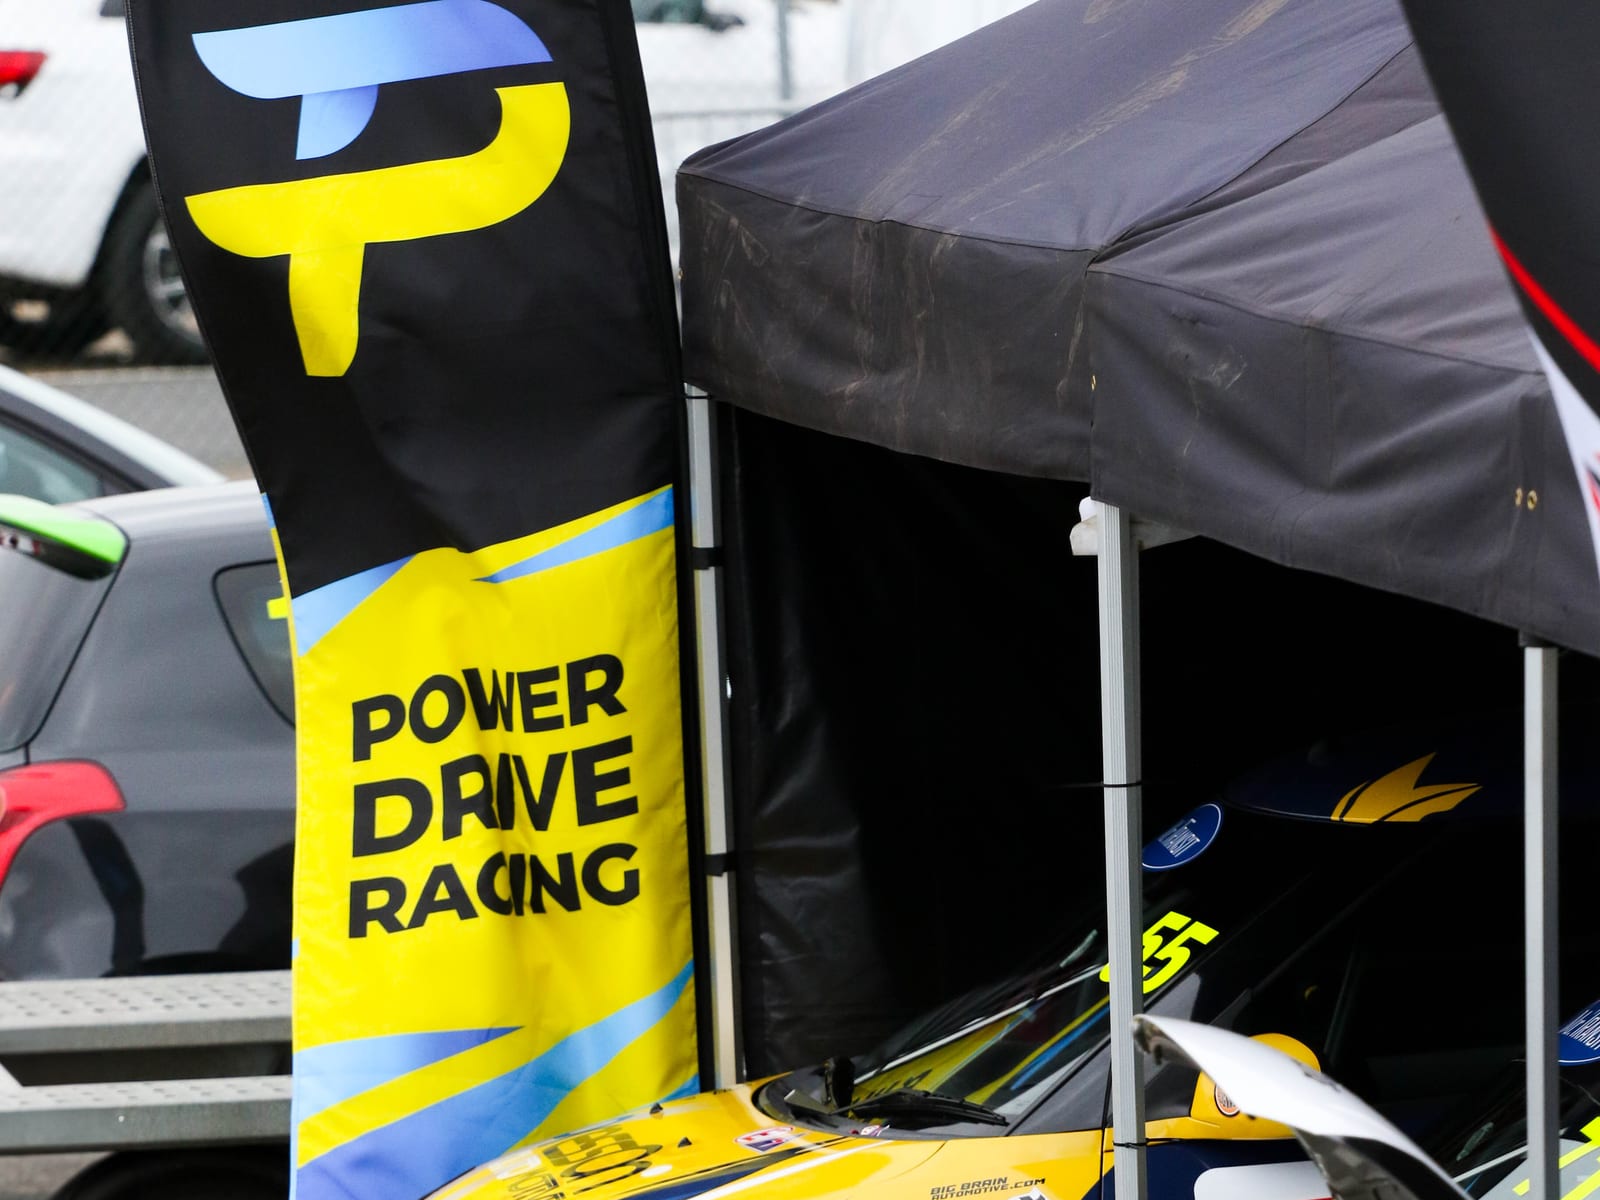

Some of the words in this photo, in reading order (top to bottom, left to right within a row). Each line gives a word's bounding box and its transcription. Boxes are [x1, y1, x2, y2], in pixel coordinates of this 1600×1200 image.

[352, 653, 628, 762] POWER
[352, 735, 640, 858] DRIVE
[348, 842, 641, 939] RACING
[930, 1184, 957, 1196] BIG
[960, 1176, 1008, 1191] BRAIN
[931, 1178, 1046, 1200] AUTOMOTIVE.COM
